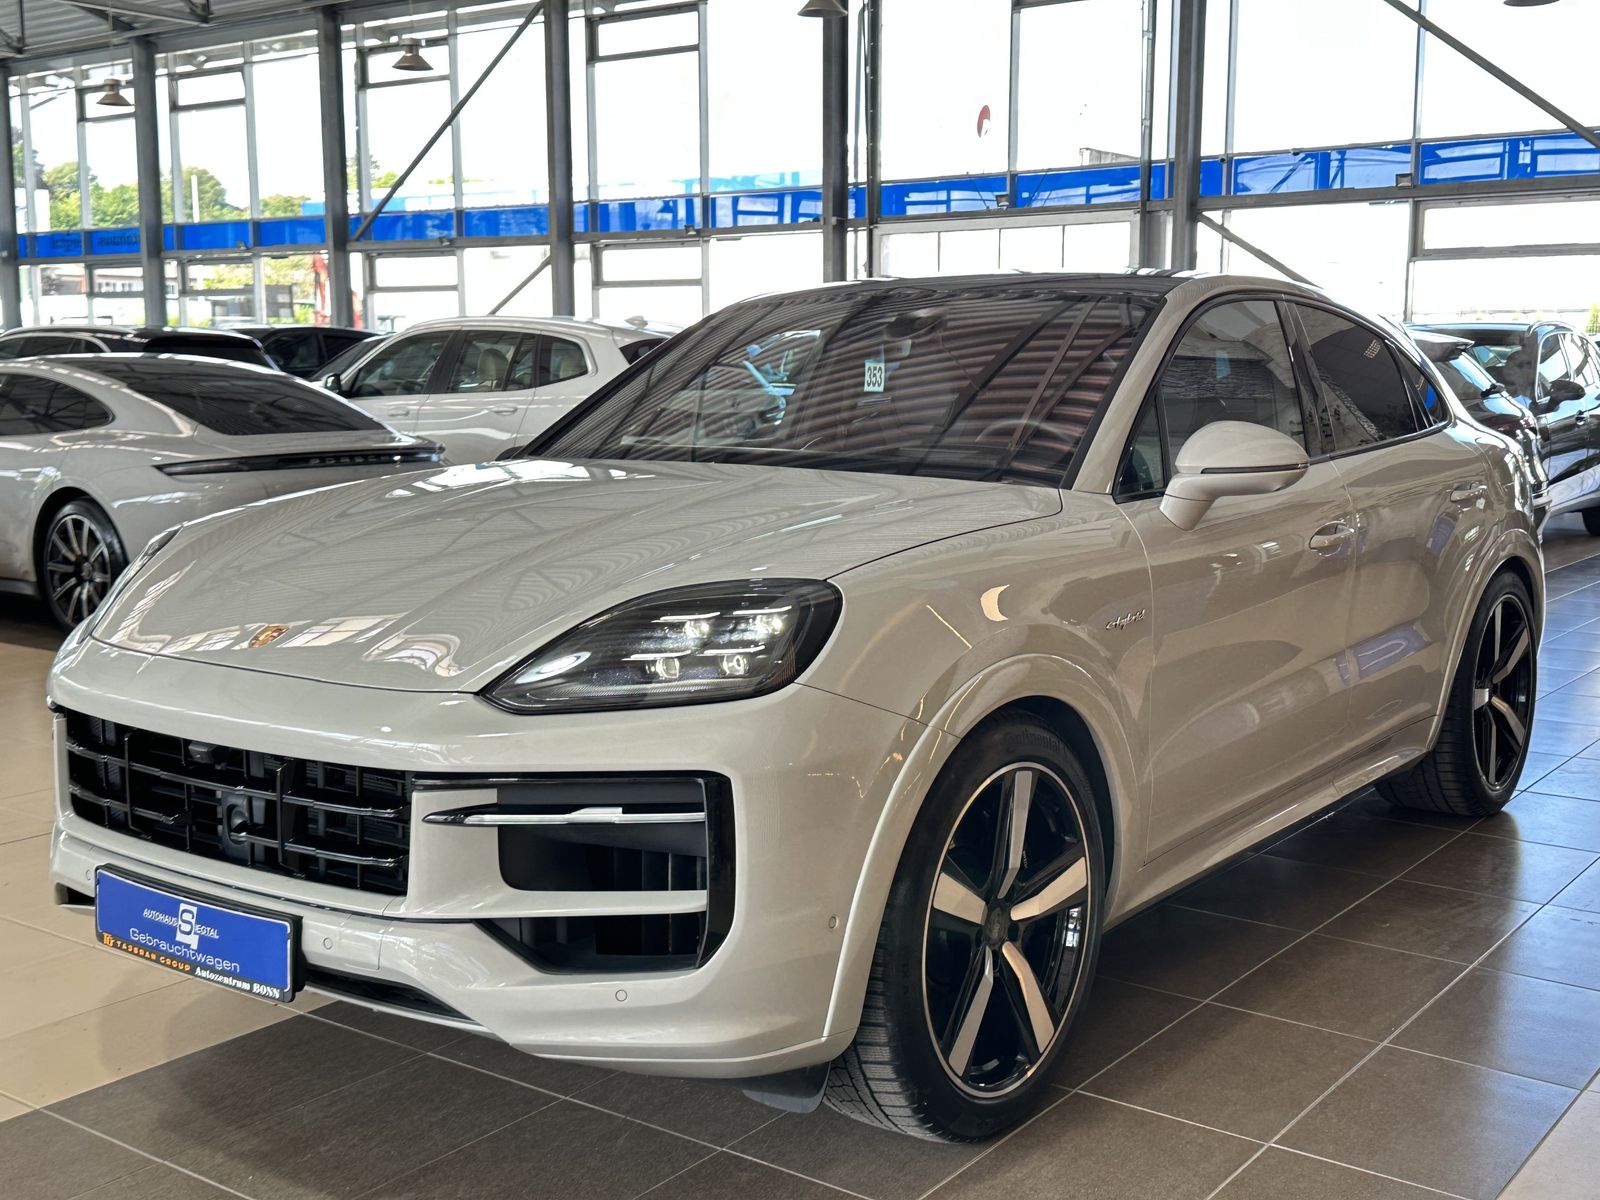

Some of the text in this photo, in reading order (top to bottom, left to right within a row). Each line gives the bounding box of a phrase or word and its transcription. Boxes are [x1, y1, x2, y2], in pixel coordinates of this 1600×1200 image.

[866, 366, 883, 388] 353
[130, 927, 240, 973] Gebrauchtwagen
[159, 956, 191, 971] GROUP
[194, 966, 251, 990] Autozentrum
[252, 983, 280, 999] BONN
